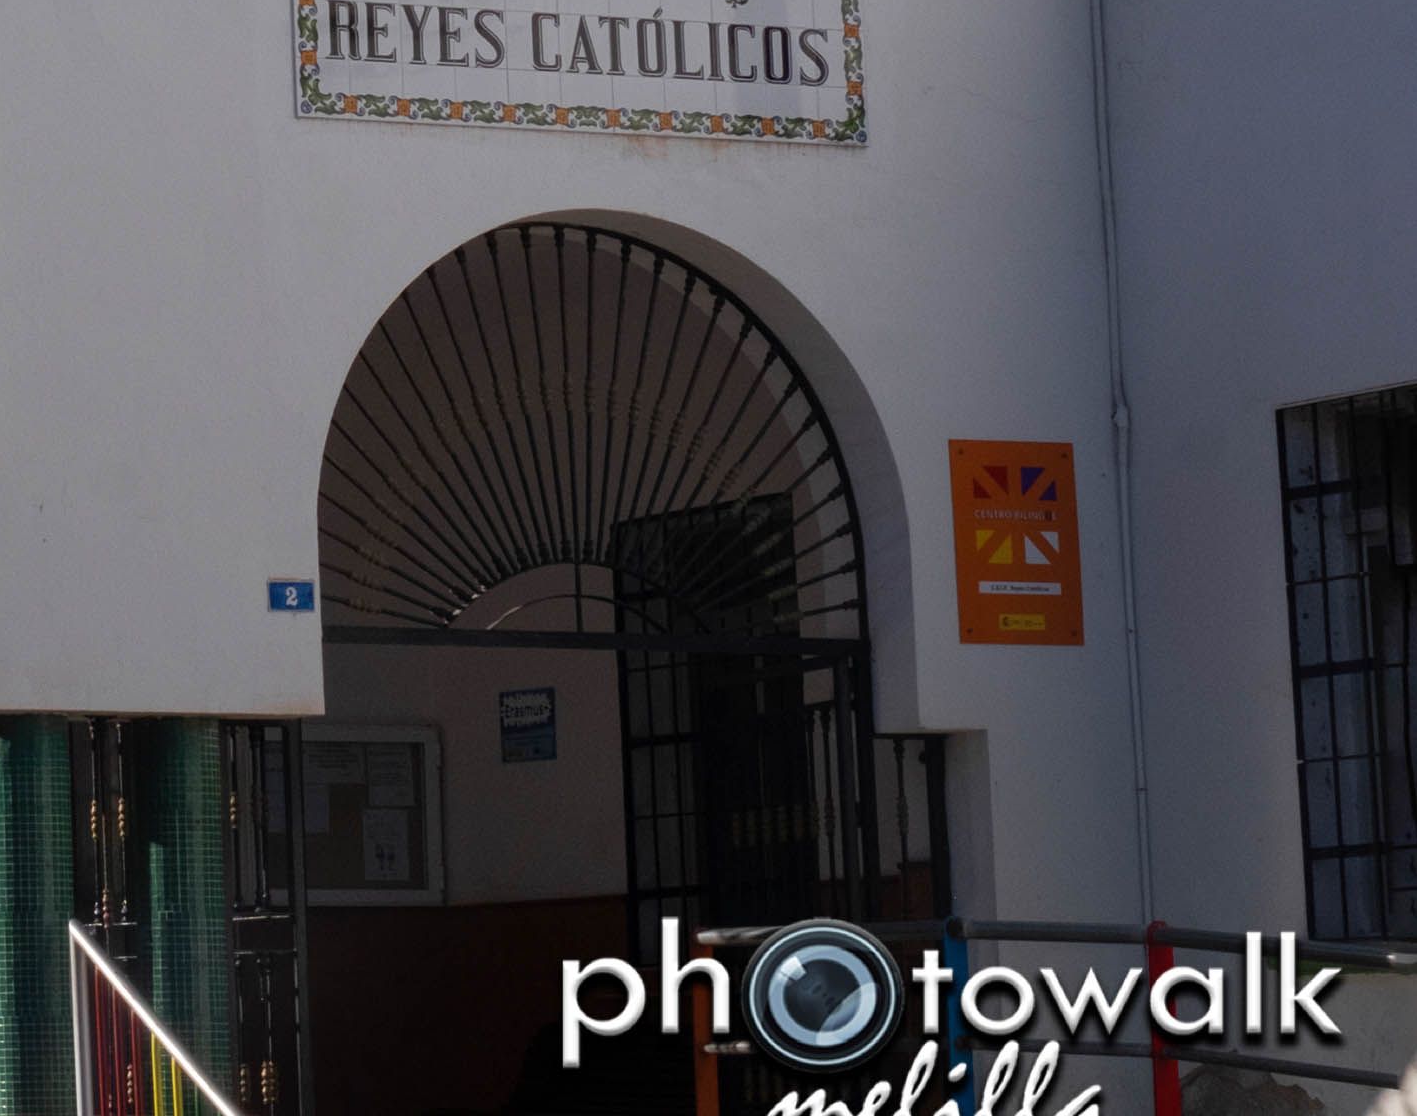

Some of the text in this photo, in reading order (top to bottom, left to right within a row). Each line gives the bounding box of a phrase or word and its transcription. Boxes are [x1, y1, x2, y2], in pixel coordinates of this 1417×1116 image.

[326, 0, 830, 86] REYES CATÓLICOS
[286, 586, 298, 606] 2
